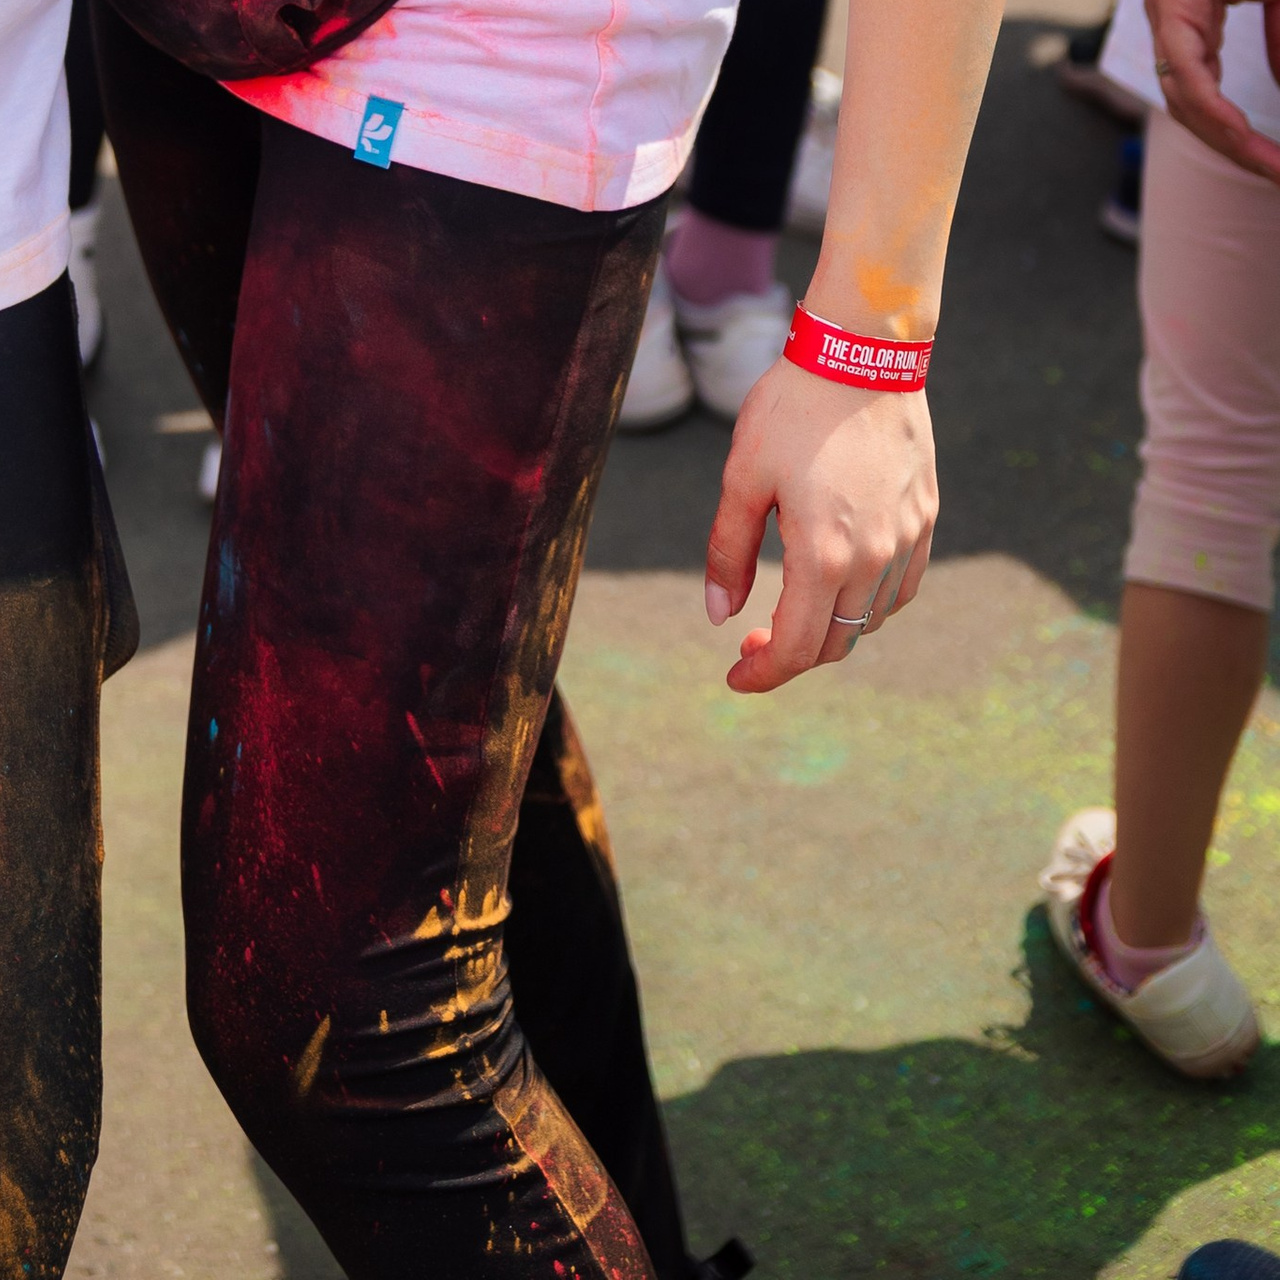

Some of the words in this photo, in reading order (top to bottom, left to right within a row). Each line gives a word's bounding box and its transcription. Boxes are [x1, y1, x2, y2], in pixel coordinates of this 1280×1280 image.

[822, 333, 851, 362] THE
[849, 343, 894, 369] COLOR
[826, 358, 878, 381] amazing
[879, 368, 901, 381] tour
